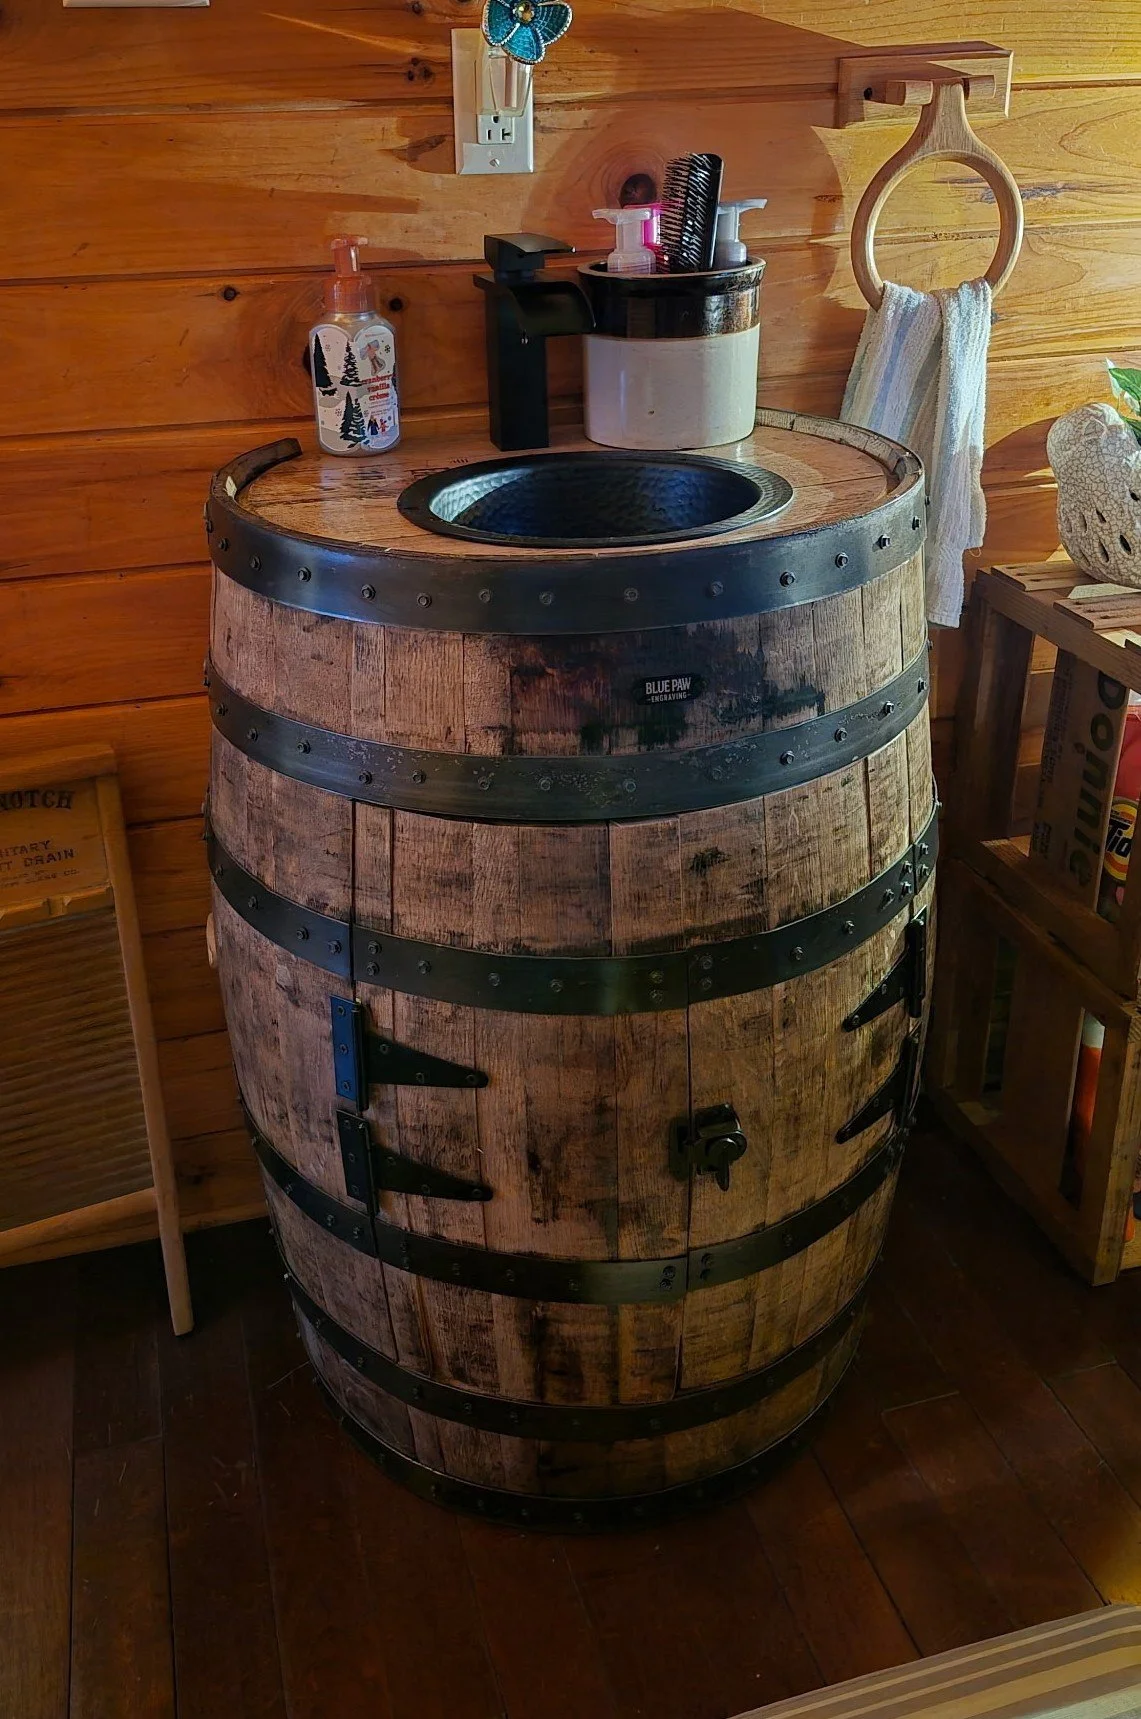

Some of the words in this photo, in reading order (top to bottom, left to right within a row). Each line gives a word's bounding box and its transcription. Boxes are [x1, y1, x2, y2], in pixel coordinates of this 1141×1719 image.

[645, 680, 671, 695] BLUE
[672, 677, 692, 692] PAW
[651, 691, 687, 703] ENGRAVING
[23, 848, 75, 867] DRAIN
